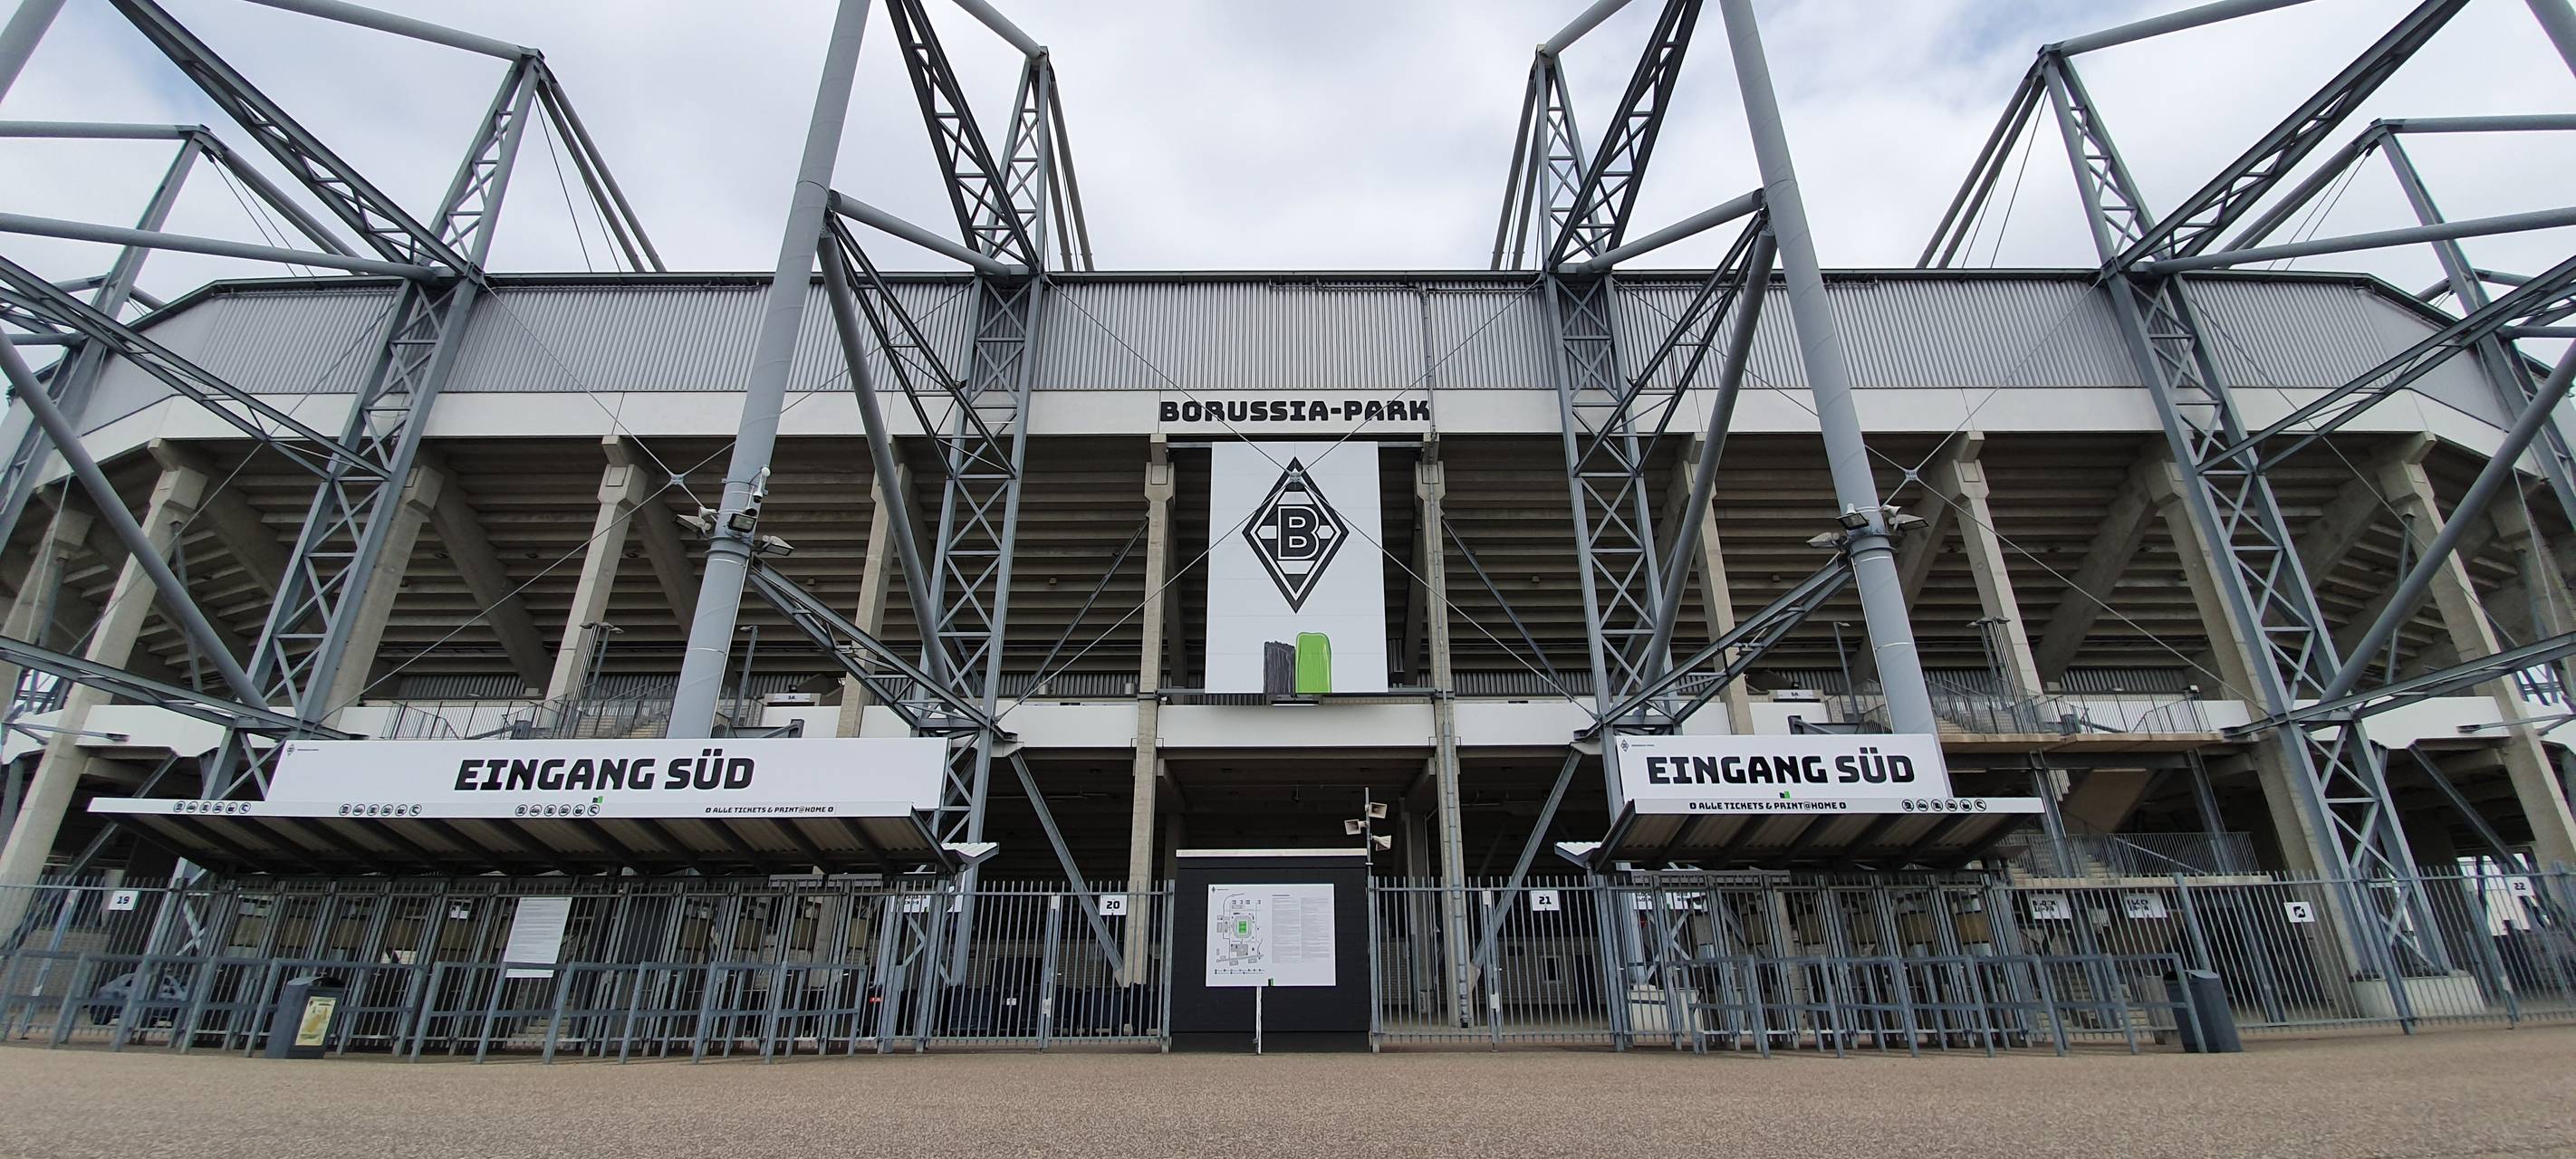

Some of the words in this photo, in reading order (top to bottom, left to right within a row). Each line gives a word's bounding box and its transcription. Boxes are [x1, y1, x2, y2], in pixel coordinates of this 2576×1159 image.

[1160, 400, 1430, 422] BORUSSIA-PARK
[1278, 506, 1320, 560] B
[454, 759, 656, 790] EINGANG
[664, 749, 755, 790] SÜD
[1647, 756, 1828, 784] EINGANG
[1834, 747, 1915, 784] SÜD
[1773, 801, 1837, 810] PRINT@HOME
[2514, 882, 2526, 890] 22
[116, 896, 130, 905] 19
[1106, 900, 1120, 909] 20
[1539, 896, 1552, 905] 21
